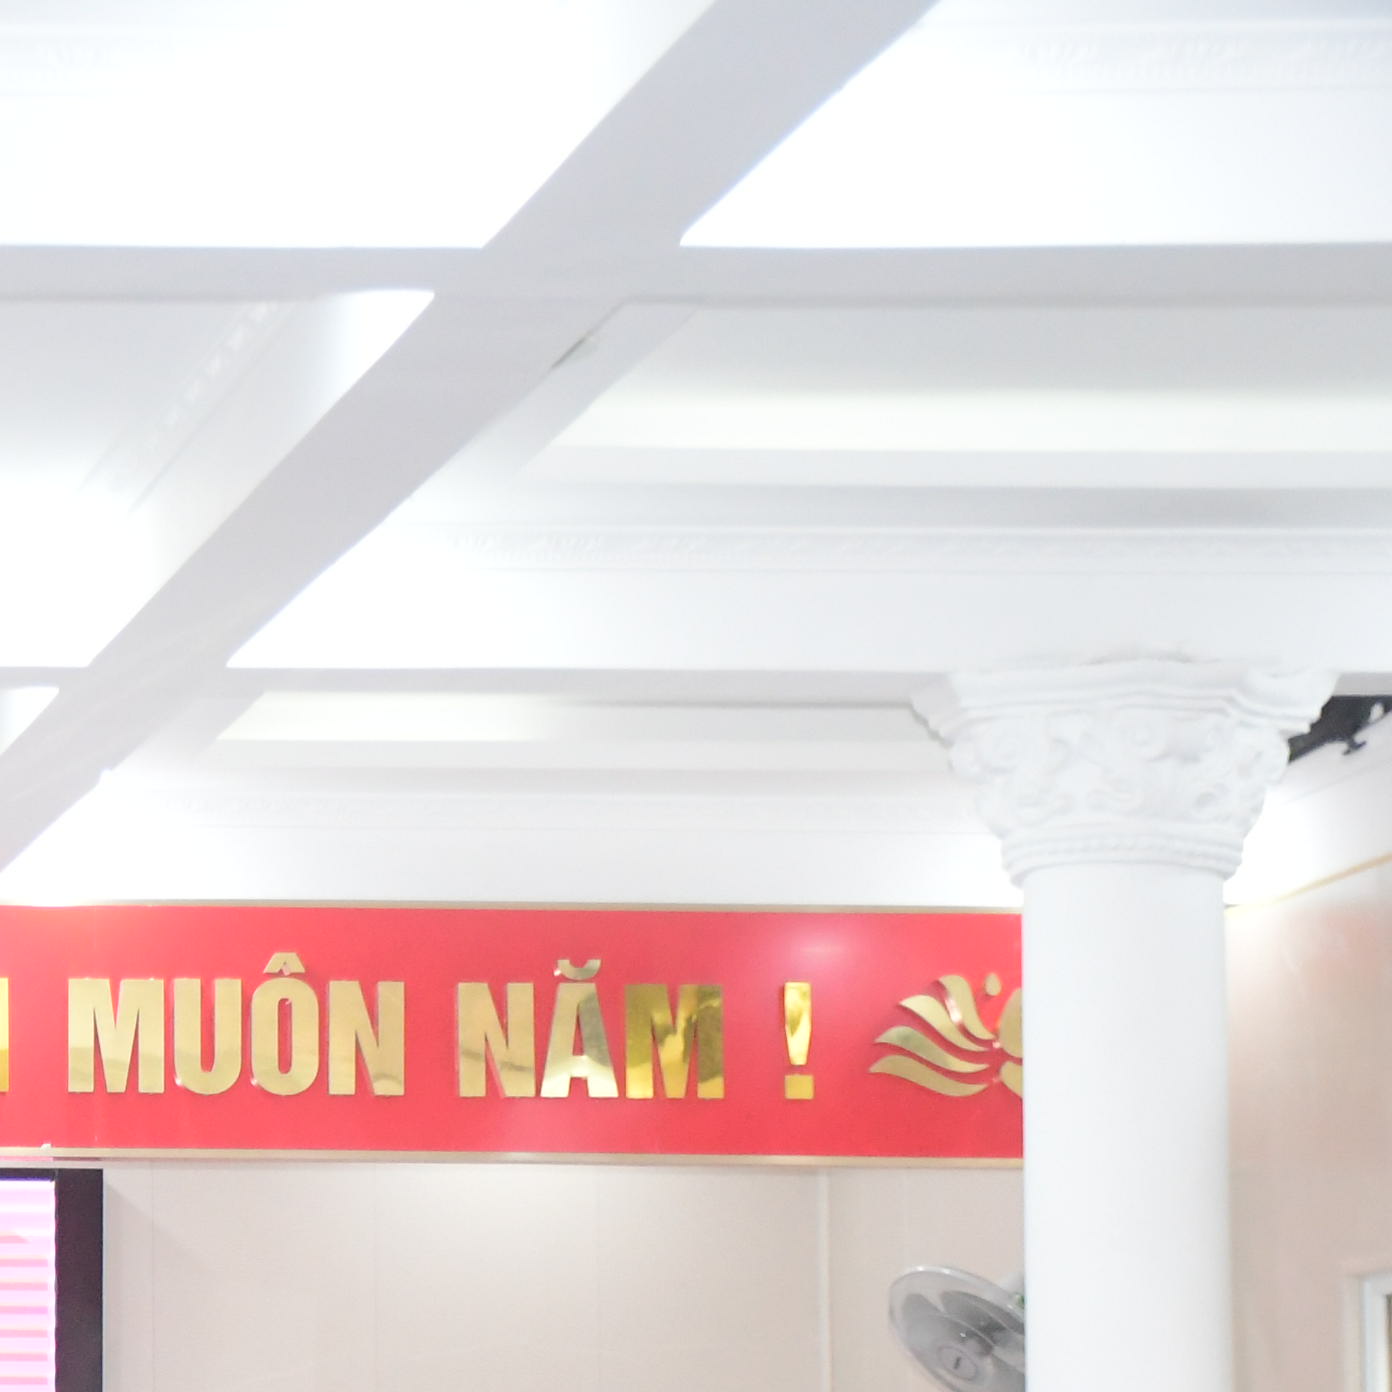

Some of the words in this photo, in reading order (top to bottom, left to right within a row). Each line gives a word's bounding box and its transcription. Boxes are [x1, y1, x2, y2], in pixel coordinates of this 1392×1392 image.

[67, 952, 405, 1096] MUÔN
[457, 958, 726, 1100] NĂM
[783, 981, 815, 1100] !
